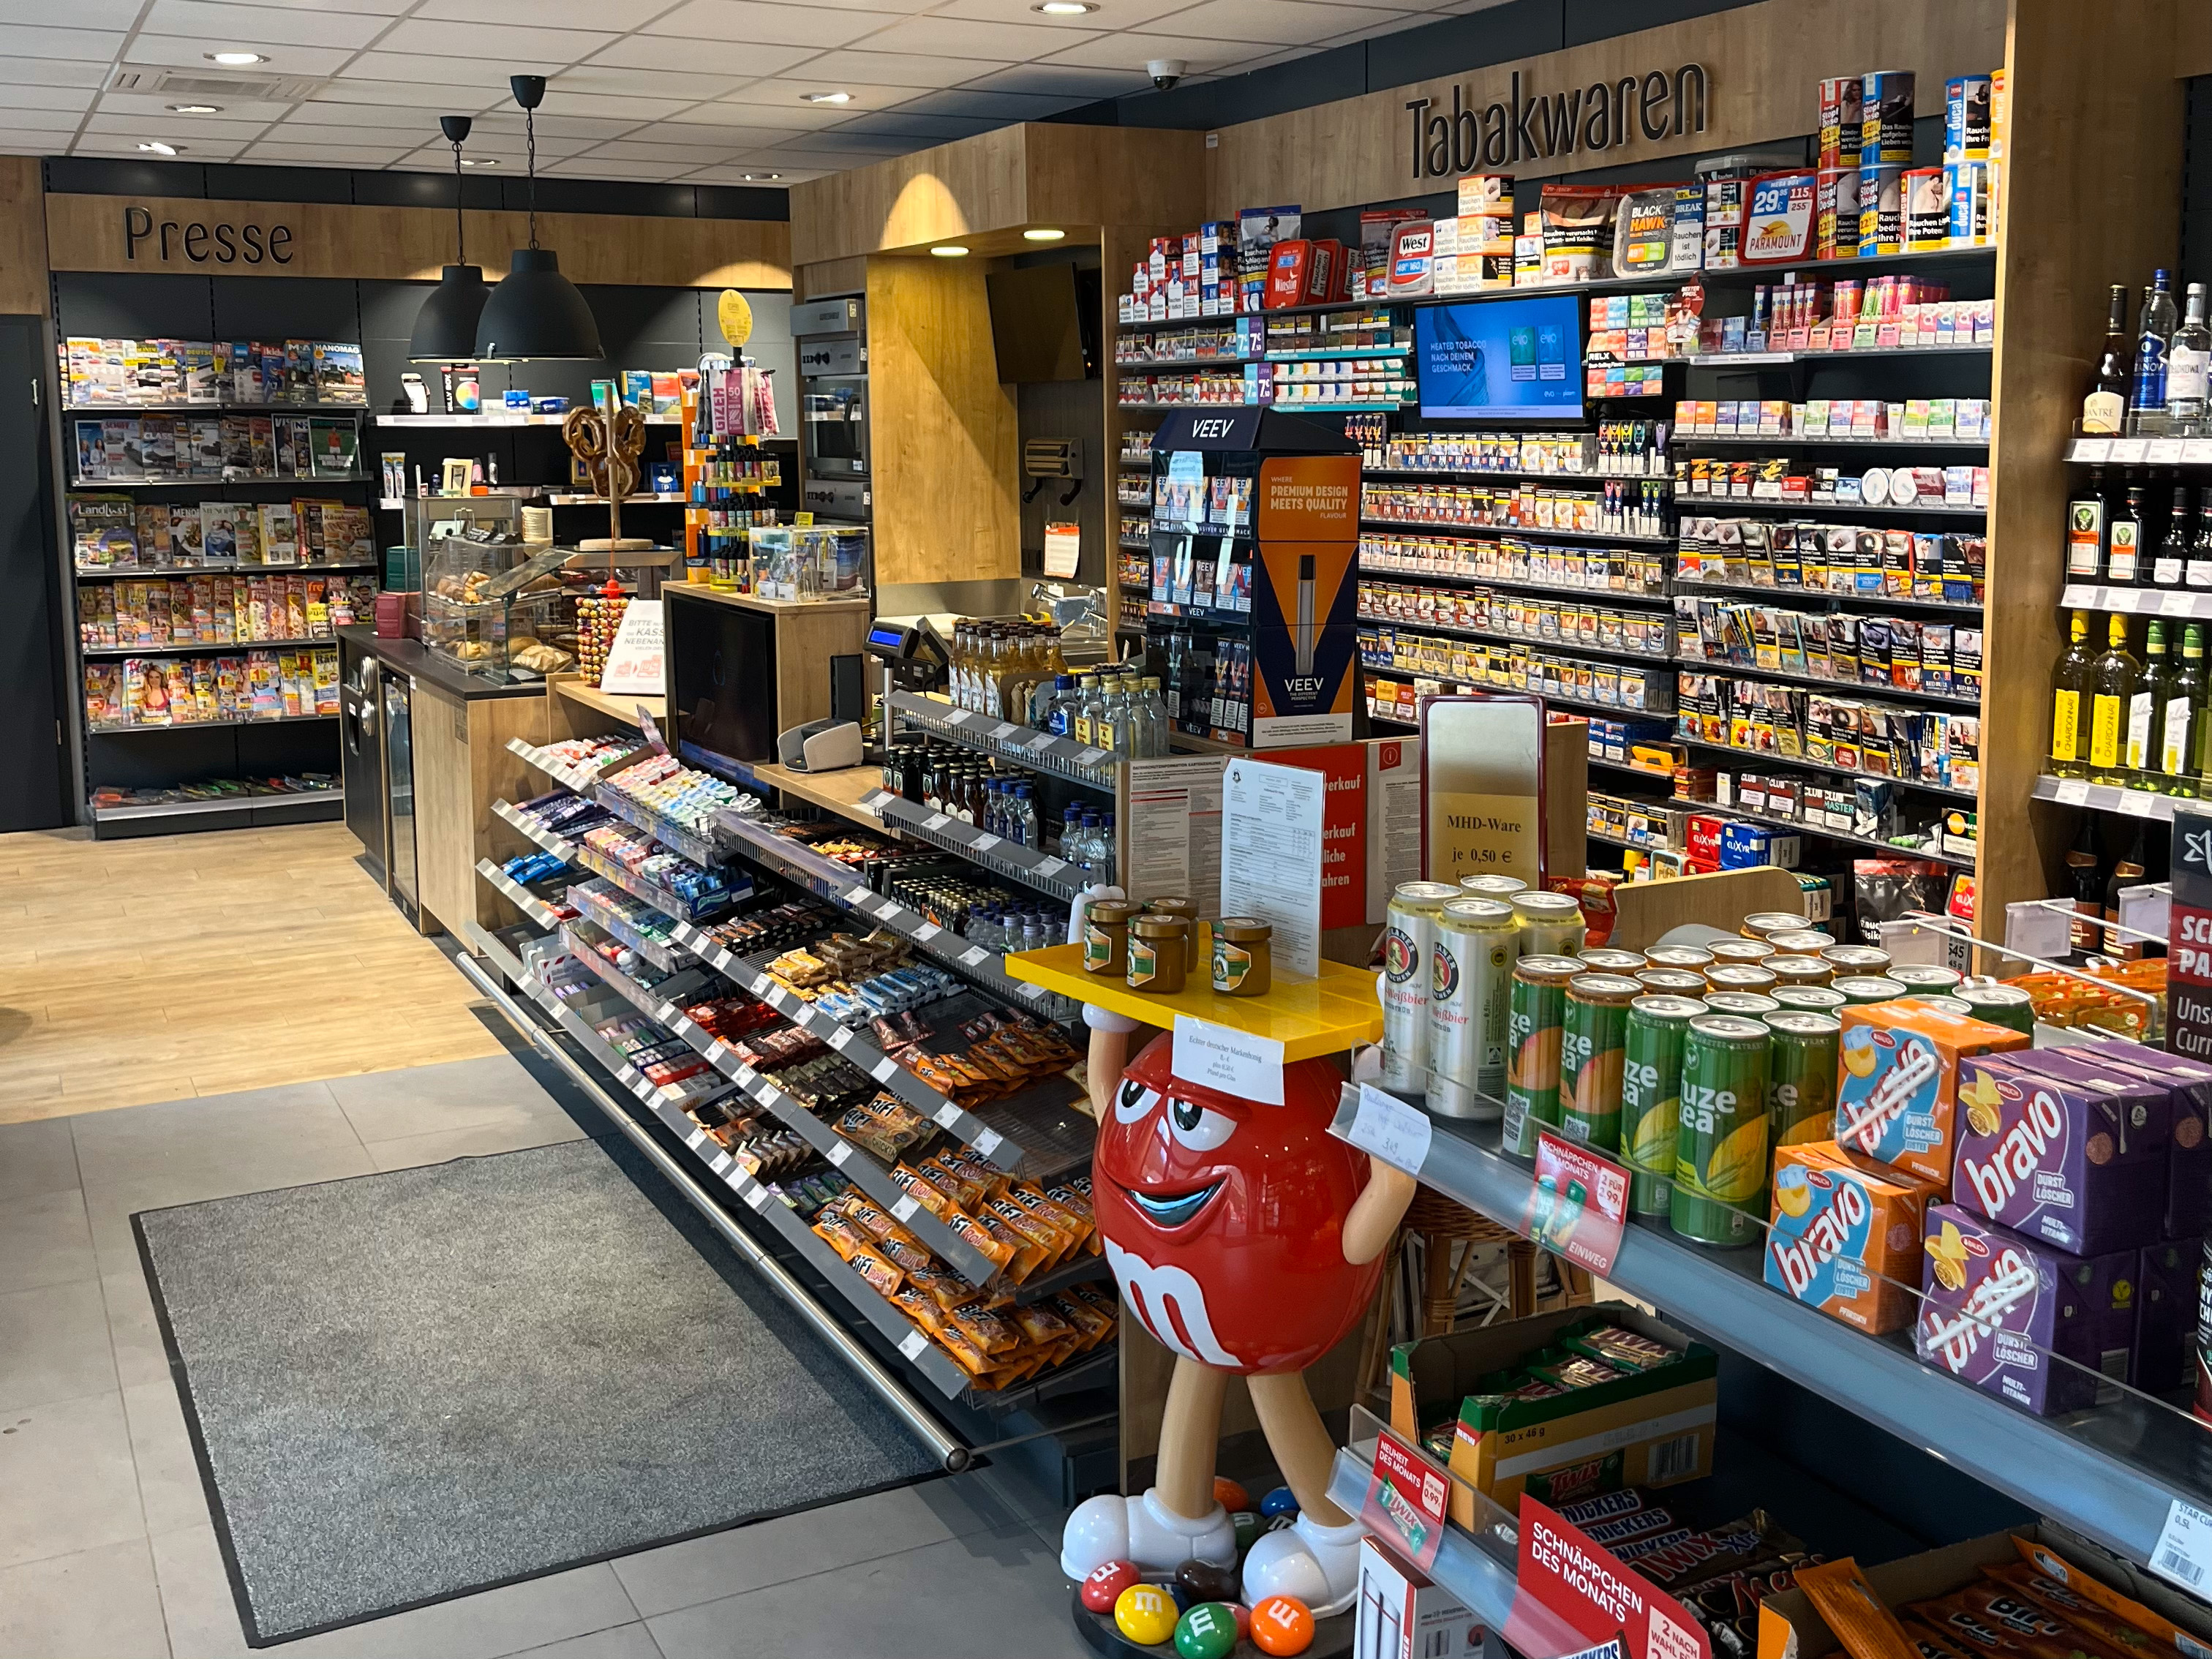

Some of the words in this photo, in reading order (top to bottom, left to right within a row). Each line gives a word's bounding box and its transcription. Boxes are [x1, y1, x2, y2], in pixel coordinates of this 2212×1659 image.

[1405, 63, 1707, 178] Tabakwaren
[1946, 99, 1963, 130] ducal
[1632, 205, 1662, 218] BLACK
[1675, 203, 1703, 213] BREAK
[1791, 203, 1807, 211] 255
[1630, 217, 1666, 231] HAWK
[124, 206, 294, 265] Presse
[1402, 236, 1427, 250] West
[1750, 234, 1802, 251] PARAMOUNT
[1674, 252, 1696, 260] tödlich
[1275, 277, 1297, 293] Winston
[315, 345, 360, 354] HANOMAG
[1430, 342, 1455, 351] HEATED
[1456, 339, 1486, 350] TOBACCO
[1432, 353, 1449, 361] NACH
[1451, 351, 1474, 361] DEINEM
[1589, 353, 1610, 361] RELX
[728, 386, 741, 396] 50
[713, 388, 726, 431] GIZEH
[1192, 419, 1235, 439] VEEV
[1271, 485, 1314, 497] PREMIUM
[1315, 485, 1349, 497] DESIGN
[1270, 498, 1304, 511] MEETS
[1306, 497, 1348, 511] QUALITY
[1188, 607, 1205, 617] VEEV
[1284, 677, 1325, 693] VEEV
[1185, 723, 1202, 734] VEEV
[2065, 697, 2075, 751] CHARDONNAY
[2104, 702, 2115, 759] CHARDONNAY
[1741, 773, 1756, 783] CLUB
[1769, 778, 1785, 789] CLUB
[1804, 786, 1823, 798] CLUB
[1824, 790, 1844, 802] CLUB
[1824, 801, 1854, 814] MASTER
[1323, 822, 1355, 840] erkauf
[1447, 815, 1521, 832] MHD-Ware
[1323, 849, 1346, 864] liche
[1452, 847, 1463, 862] je
[1470, 849, 1496, 864] 0,50
[1502, 851, 1512, 863] €
[1322, 873, 1350, 887] ahren
[1189, 1035, 1205, 1046] Echter
[1206, 1040, 1230, 1053] deutscher
[1230, 1047, 1262, 1064] Markenhonig
[1906, 1126, 1940, 1141] LÖSCHER
[1543, 1140, 1598, 1174] SCHNÄPPCHEN
[1960, 1091, 2061, 1219] bravo
[1559, 1159, 1589, 1181] MONATS
[1601, 1174, 1607, 1185] 2
[1609, 1179, 1622, 1193] FÜR
[2036, 1174, 2064, 1189] DURST
[2036, 1188, 2072, 1205] LÖSCHER
[1771, 1181, 1865, 1300] bravo
[1568, 1241, 1607, 1269] EINWEG
[1835, 1272, 1868, 1289] LÖSCHER
[1104, 1235, 1242, 1367] m
[1995, 1347, 2035, 1367] LÖSCHER
[2002, 1384, 2031, 1406] VITAMIN
[1505, 1434, 1516, 1445] 30
[1526, 1428, 1537, 1439] 46
[1538, 1428, 1545, 1437] g
[1380, 1440, 1409, 1467] NEUHEIT
[1379, 1451, 1392, 1467] DES
[1392, 1461, 1421, 1489] MONATS
[1390, 1496, 1418, 1529] TWIX
[1560, 1489, 1640, 1524] NICKERS
[2179, 1504, 2199, 1521] STAR
[1533, 1521, 1642, 1614] SCHNÄPPCHEN
[1532, 1541, 1560, 1573] DES
[1563, 1565, 1626, 1623] MONATS
[1135, 1592, 1162, 1613] m
[1651, 1629, 1677, 1658] WAHL
[1662, 1620, 1670, 1637] 2
[1672, 1631, 1698, 1658] NACH
